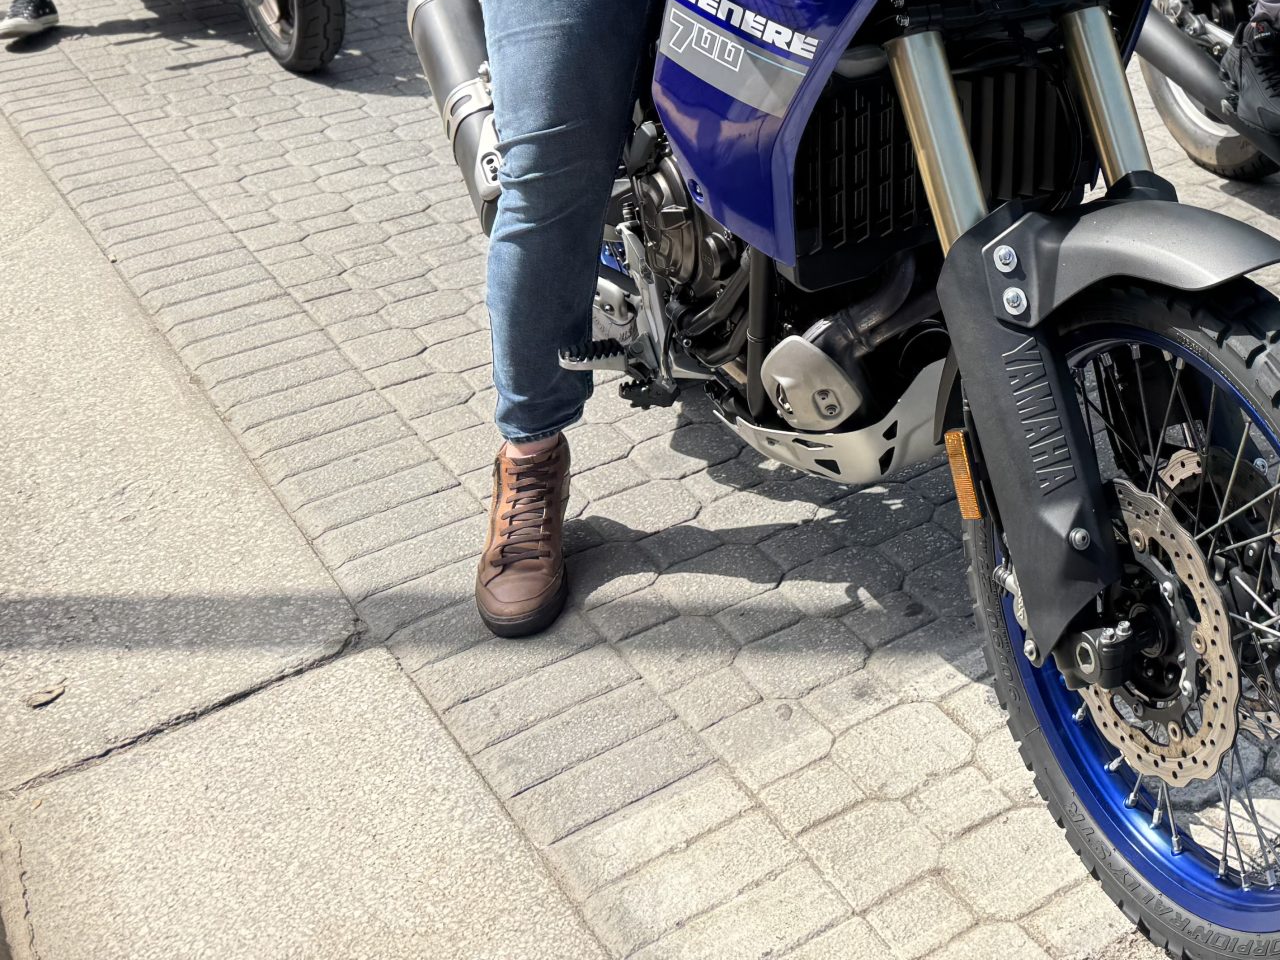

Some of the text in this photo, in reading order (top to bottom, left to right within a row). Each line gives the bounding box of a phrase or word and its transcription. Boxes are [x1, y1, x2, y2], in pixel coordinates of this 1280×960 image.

[669, 7, 744, 72] 700
[1001, 337, 1077, 497] YAMAHA
[1112, 867, 1190, 936] RALLY
